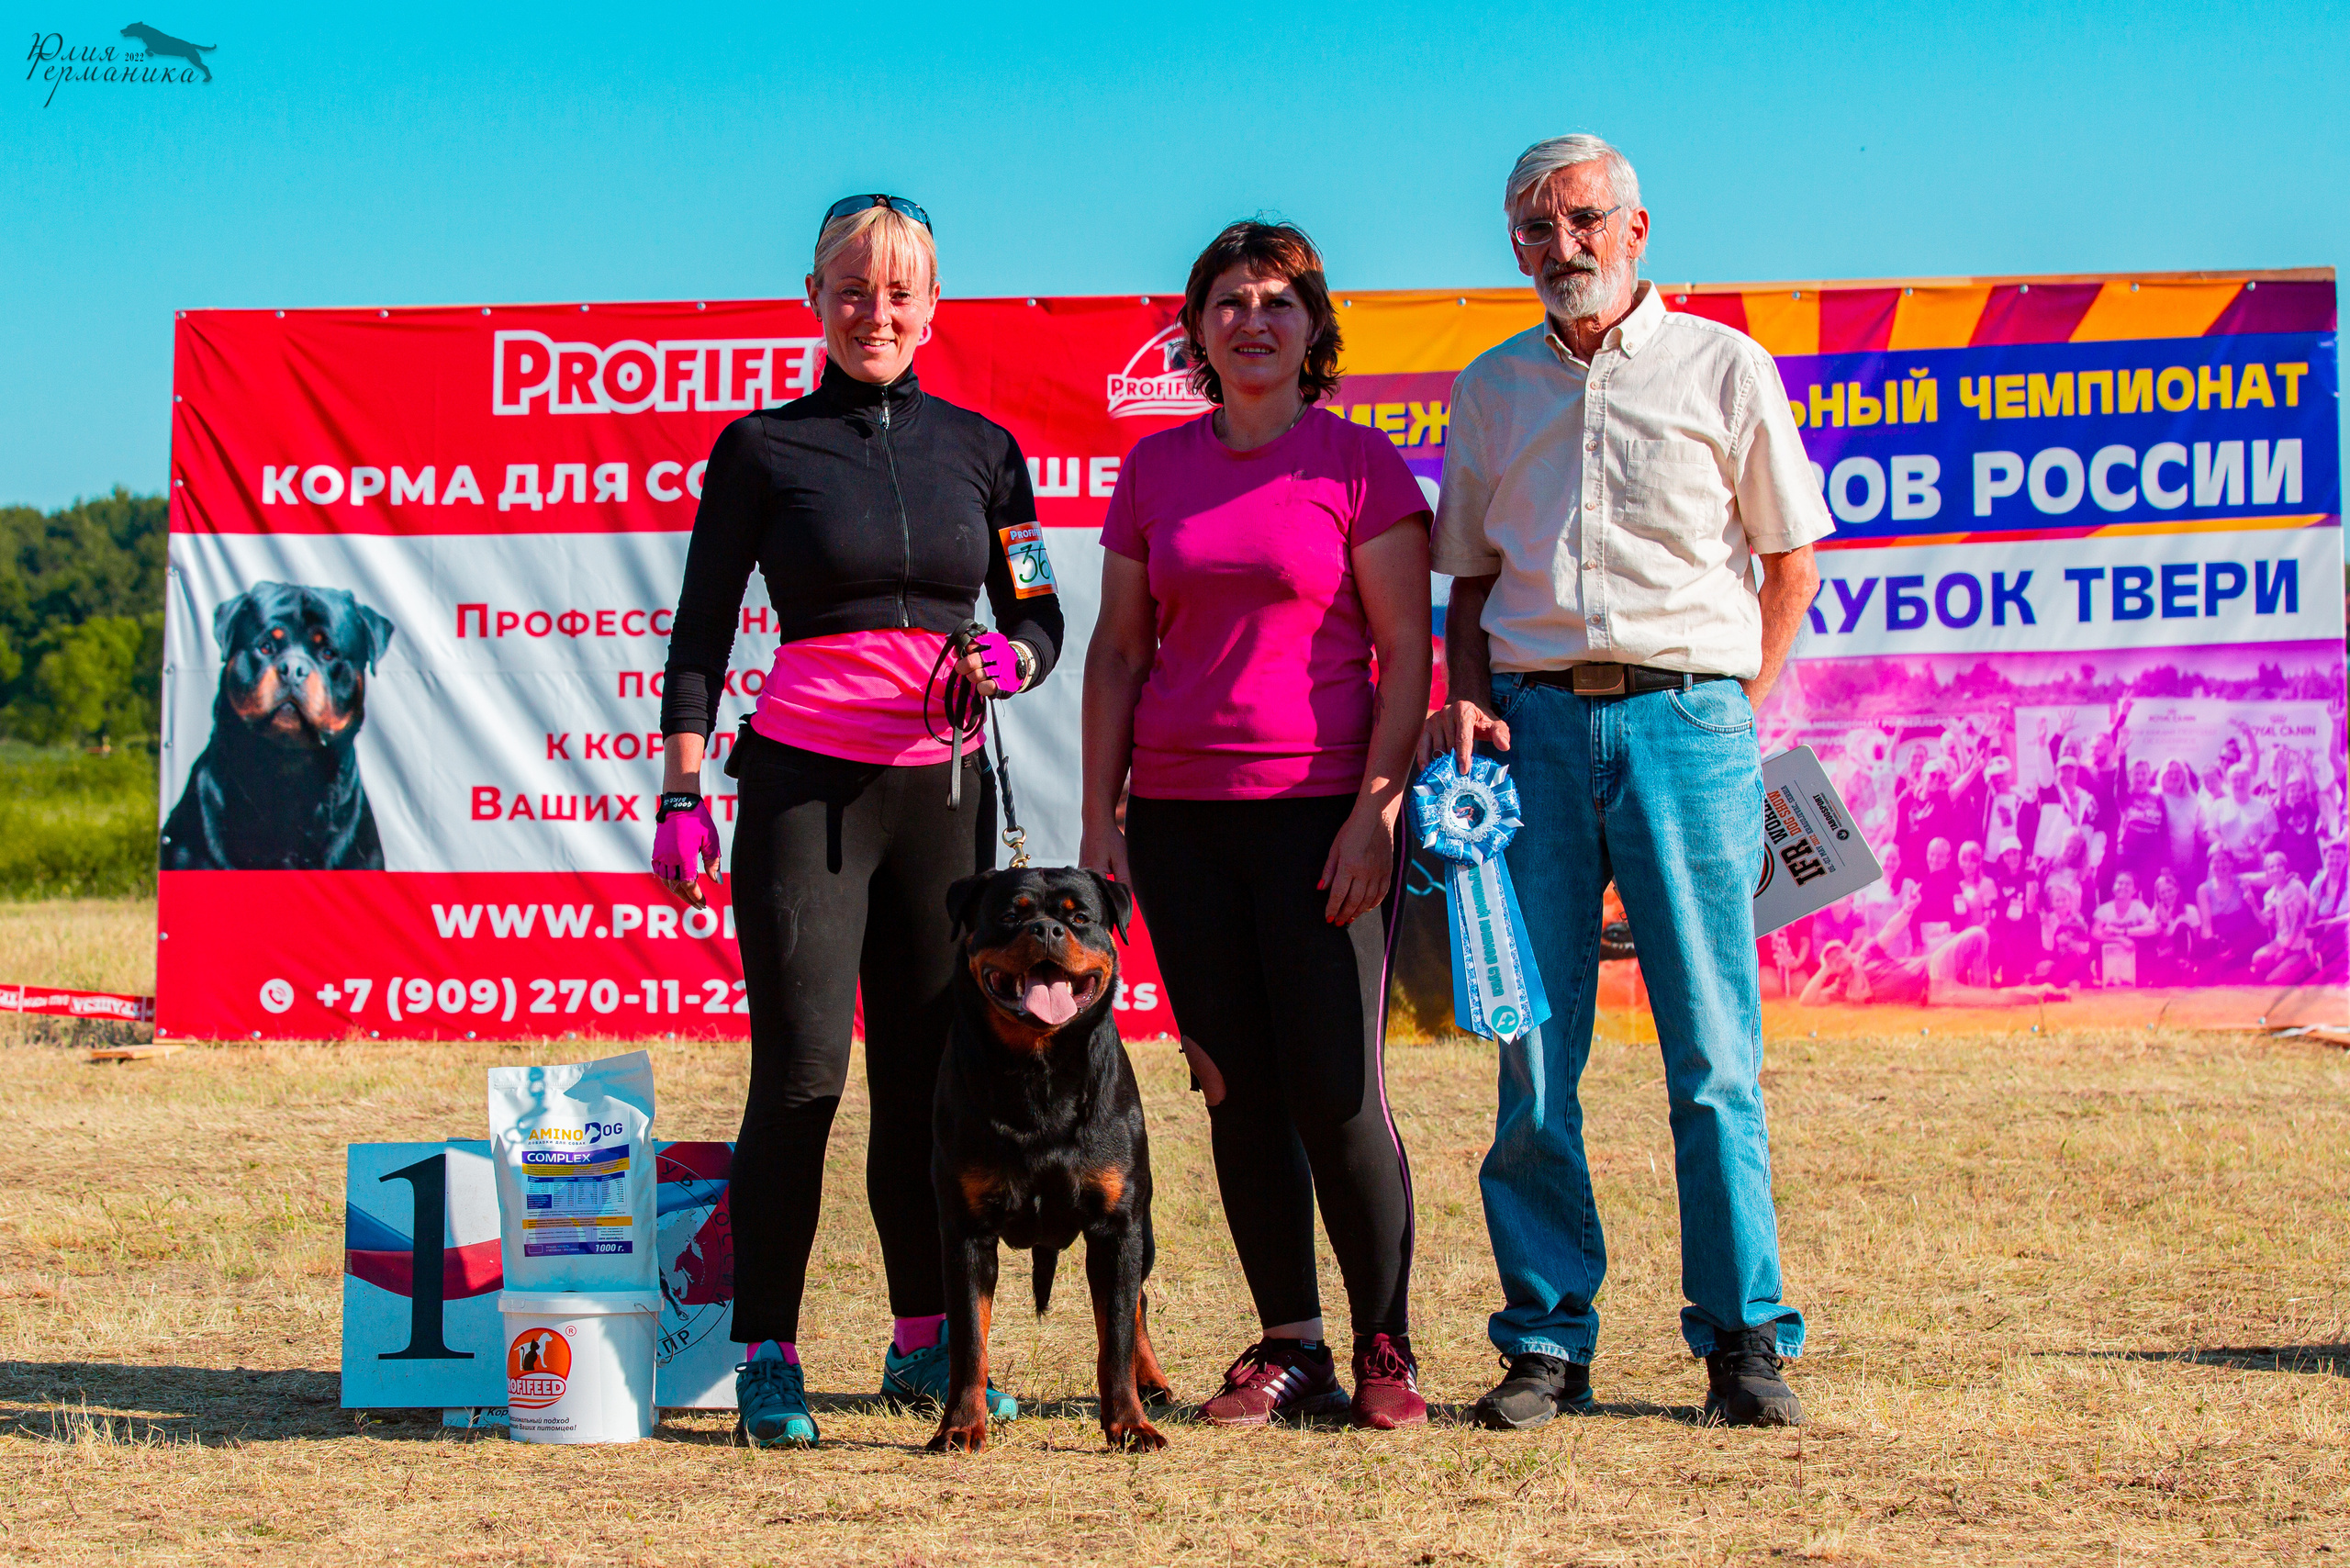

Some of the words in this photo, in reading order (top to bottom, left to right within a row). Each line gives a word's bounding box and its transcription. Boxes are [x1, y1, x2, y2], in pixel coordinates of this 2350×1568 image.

[493, 330, 828, 415] PROFIFE
[1960, 362, 2309, 420] ЧЕМПИОНАТ
[263, 465, 485, 506] КОРМА
[498, 462, 629, 511] ДЛЯ
[1974, 438, 2302, 517] РОССИИ
[2065, 558, 2299, 623] ТВЕРИ
[1763, 798, 1789, 846] WORL
[1767, 790, 1791, 818] SHOW
[1783, 816, 1802, 836] DOG
[1812, 794, 1840, 832] TABOOSPORT
[1779, 836, 1828, 888] IFR
[317, 979, 373, 1014] +7
[386, 977, 517, 1022] (909)
[529, 979, 750, 1014] 270-11-22
[1487, 966, 1505, 997] сука
[527, 1152, 591, 1163] COMPLEX
[377, 1154, 475, 1360] 1
[595, 1244, 617, 1252] 1000
